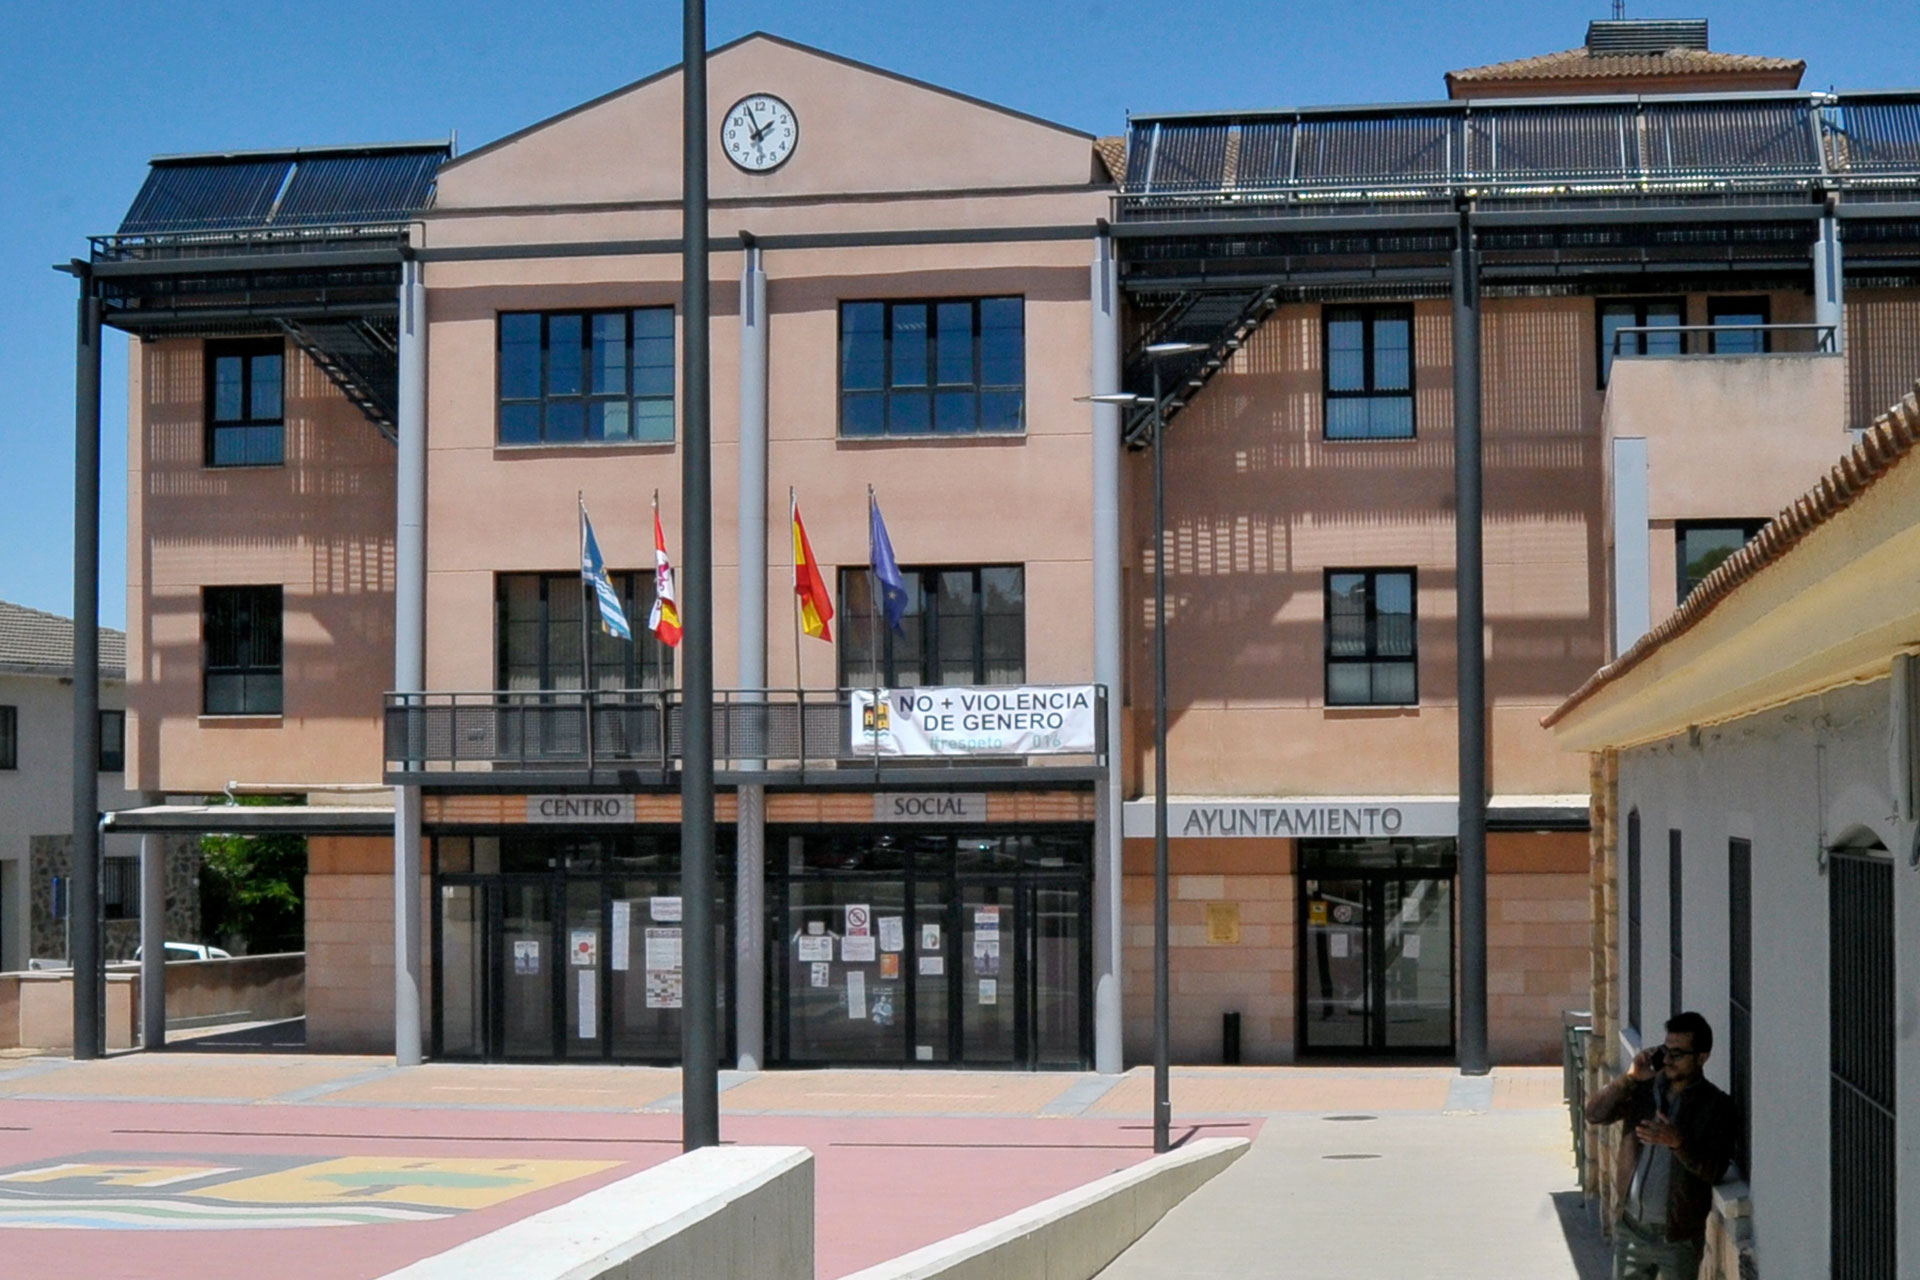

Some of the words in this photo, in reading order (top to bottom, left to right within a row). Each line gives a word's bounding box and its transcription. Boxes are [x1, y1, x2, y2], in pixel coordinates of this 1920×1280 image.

[743, 106, 751, 116] 1
[755, 101, 766, 111] 12
[771, 105, 776, 115] 1
[733, 117, 744, 126] 10
[780, 114, 787, 124] 2
[728, 130, 736, 139] 9
[784, 128, 791, 137] 3
[733, 143, 740, 152] 8
[779, 141, 785, 151] 4
[742, 152, 749, 162] 7
[756, 155, 763, 165] 6
[770, 152, 777, 161] 5
[900, 695, 934, 712] NO
[941, 698, 953, 710] +
[961, 692, 1089, 711] VIOLENCIA
[924, 715, 954, 731] DE
[963, 712, 1064, 731] GENERO
[1033, 734, 1062, 748] 016
[540, 798, 621, 816] CENTRO
[894, 797, 967, 815] SOCIAL
[1183, 808, 1403, 835] AYUNTAMIENTO
